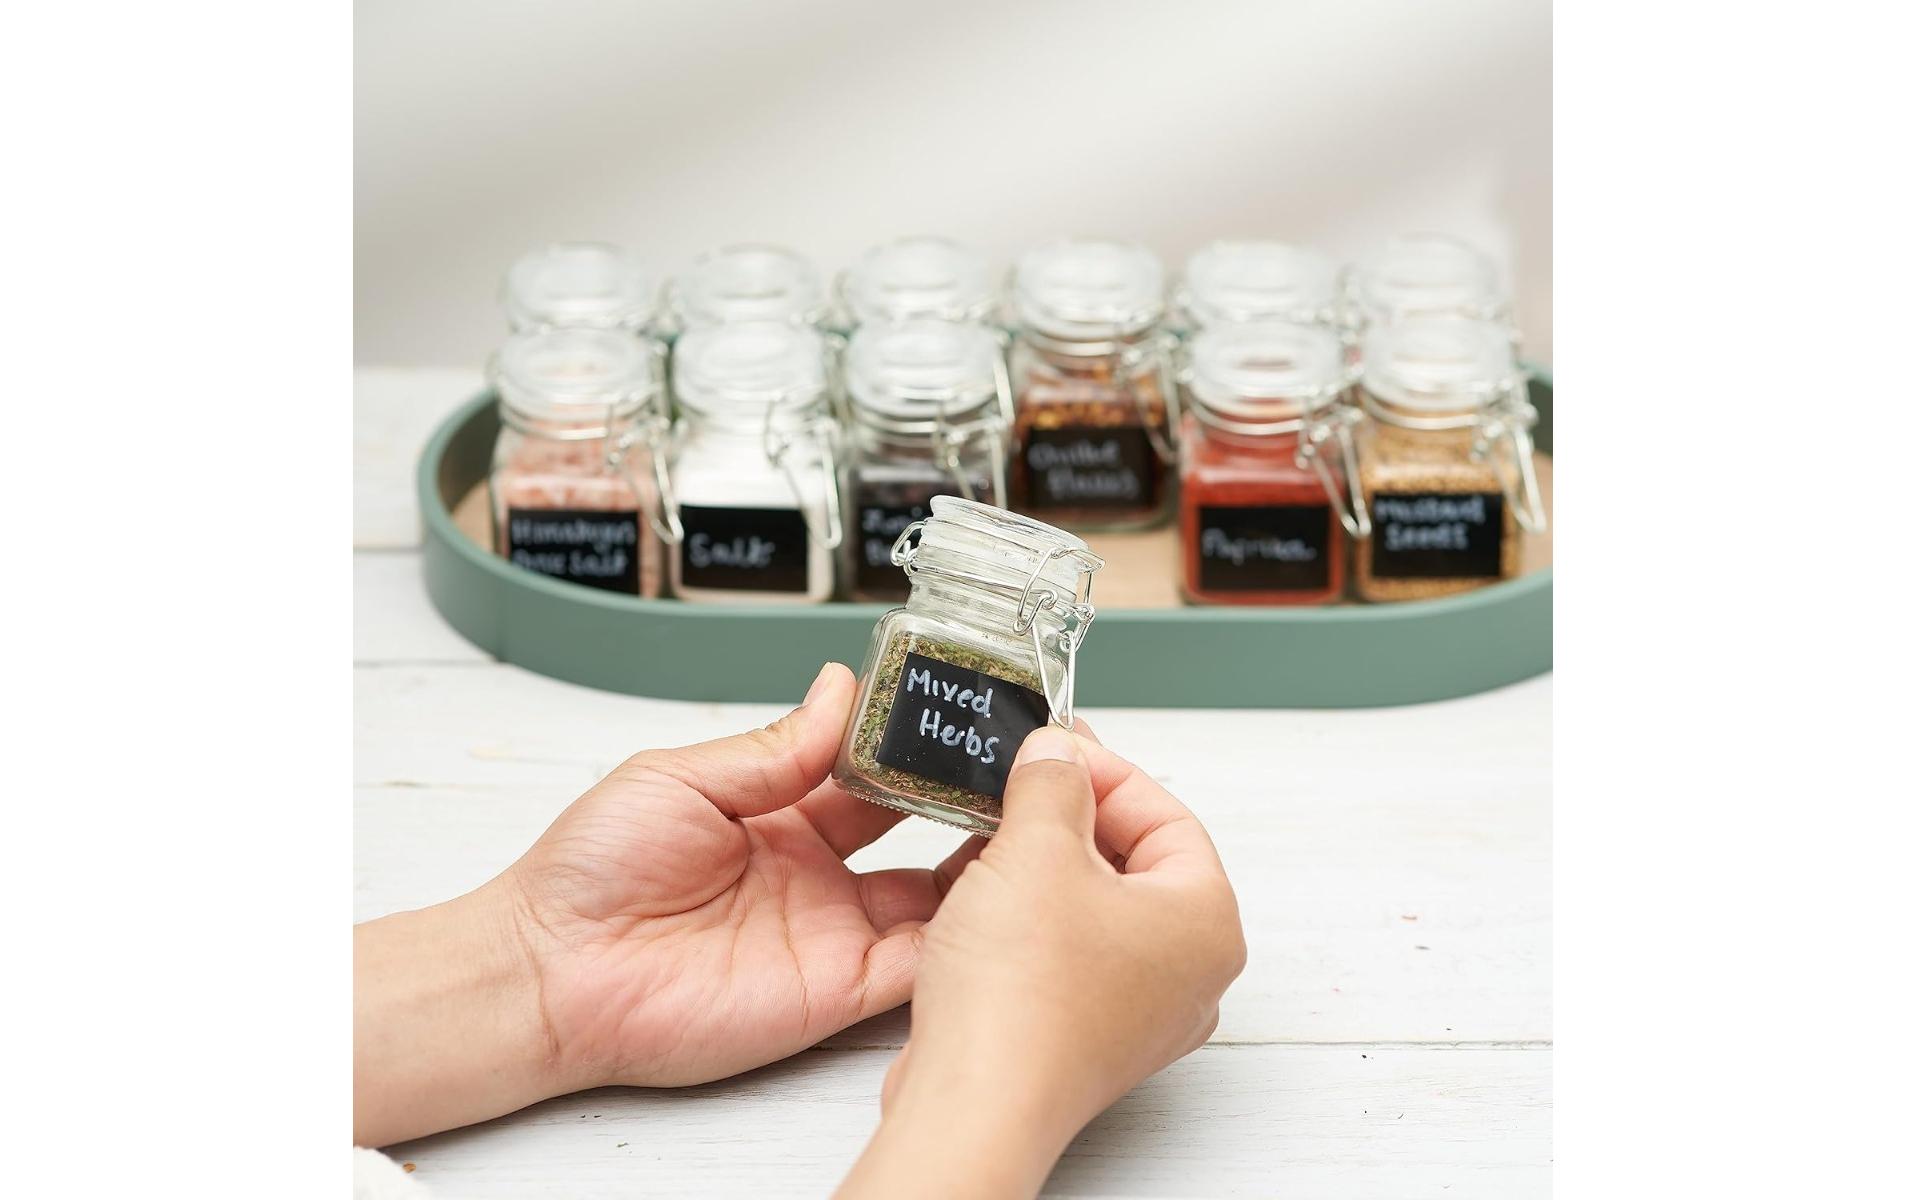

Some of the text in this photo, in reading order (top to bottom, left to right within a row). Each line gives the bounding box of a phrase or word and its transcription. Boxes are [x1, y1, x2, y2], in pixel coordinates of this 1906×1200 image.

[689, 532, 776, 568] Salt
[906, 667, 994, 718] Mixed
[919, 708, 1000, 764] Herbs
